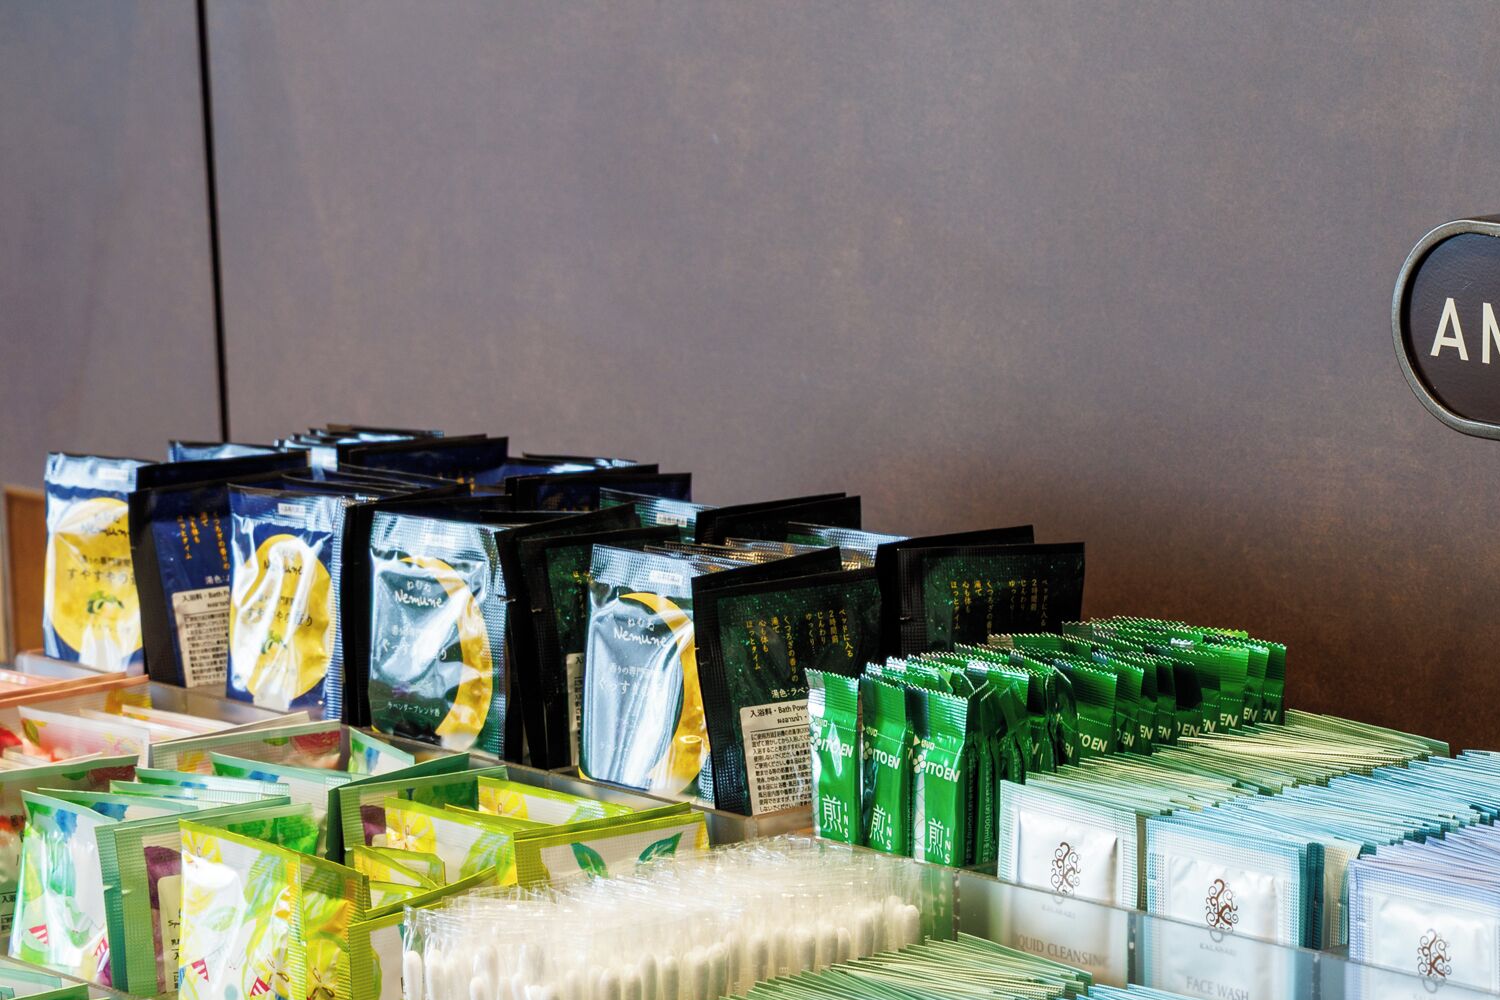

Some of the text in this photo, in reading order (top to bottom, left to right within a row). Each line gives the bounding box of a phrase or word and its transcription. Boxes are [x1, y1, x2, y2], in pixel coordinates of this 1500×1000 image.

[613, 627, 668, 647] Nemune
[839, 609, 854, 658] ベッドに入る
[778, 705, 792, 713] Bath
[1243, 707, 1258, 721] EN
[1181, 723, 1200, 737] EN
[1090, 737, 1108, 753] EN
[873, 748, 901, 770] ITO EN
[925, 761, 960, 783] ITO EN
[822, 794, 842, 833] 煎
[869, 804, 886, 844] 煎
[927, 817, 944, 858] 煎
[1186, 976, 1213, 998] FACE
